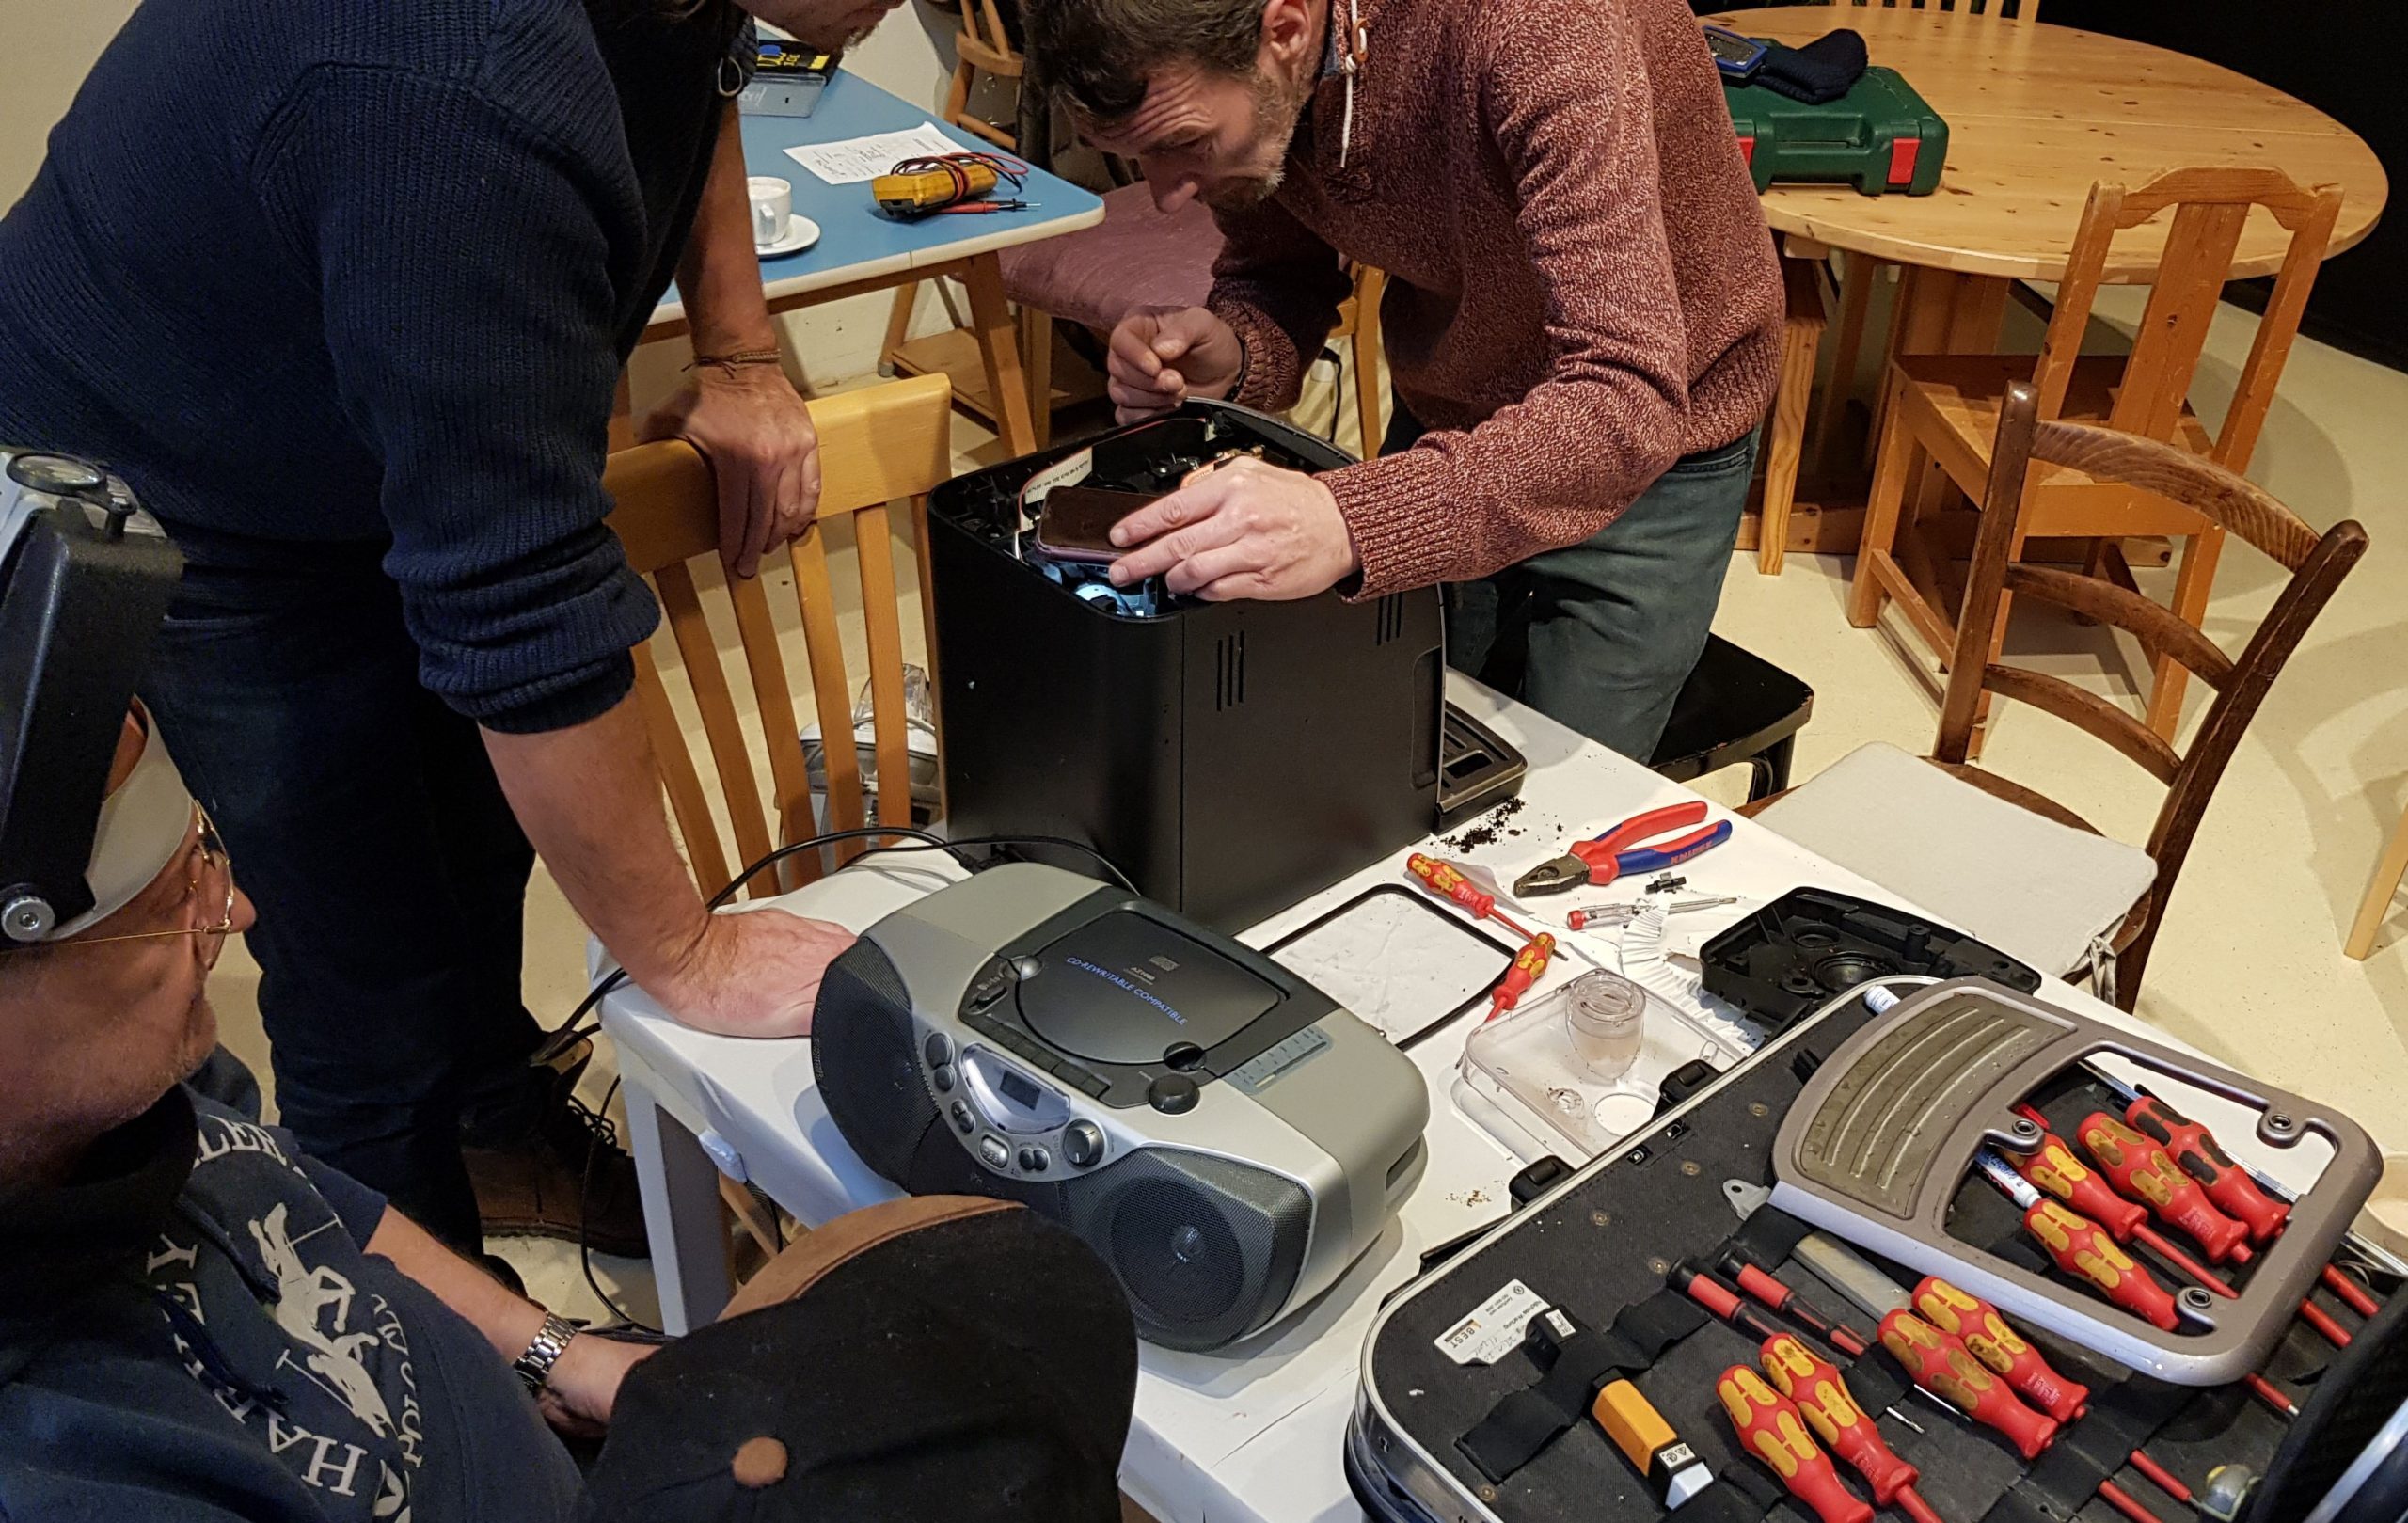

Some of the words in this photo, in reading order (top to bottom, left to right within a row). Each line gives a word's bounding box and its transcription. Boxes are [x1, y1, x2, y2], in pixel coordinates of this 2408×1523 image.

[1067, 957, 1135, 991] CD-REWRITABLE
[1133, 988, 1188, 1026] COMPATIBLE
[1450, 1327, 1476, 1350] BEST
